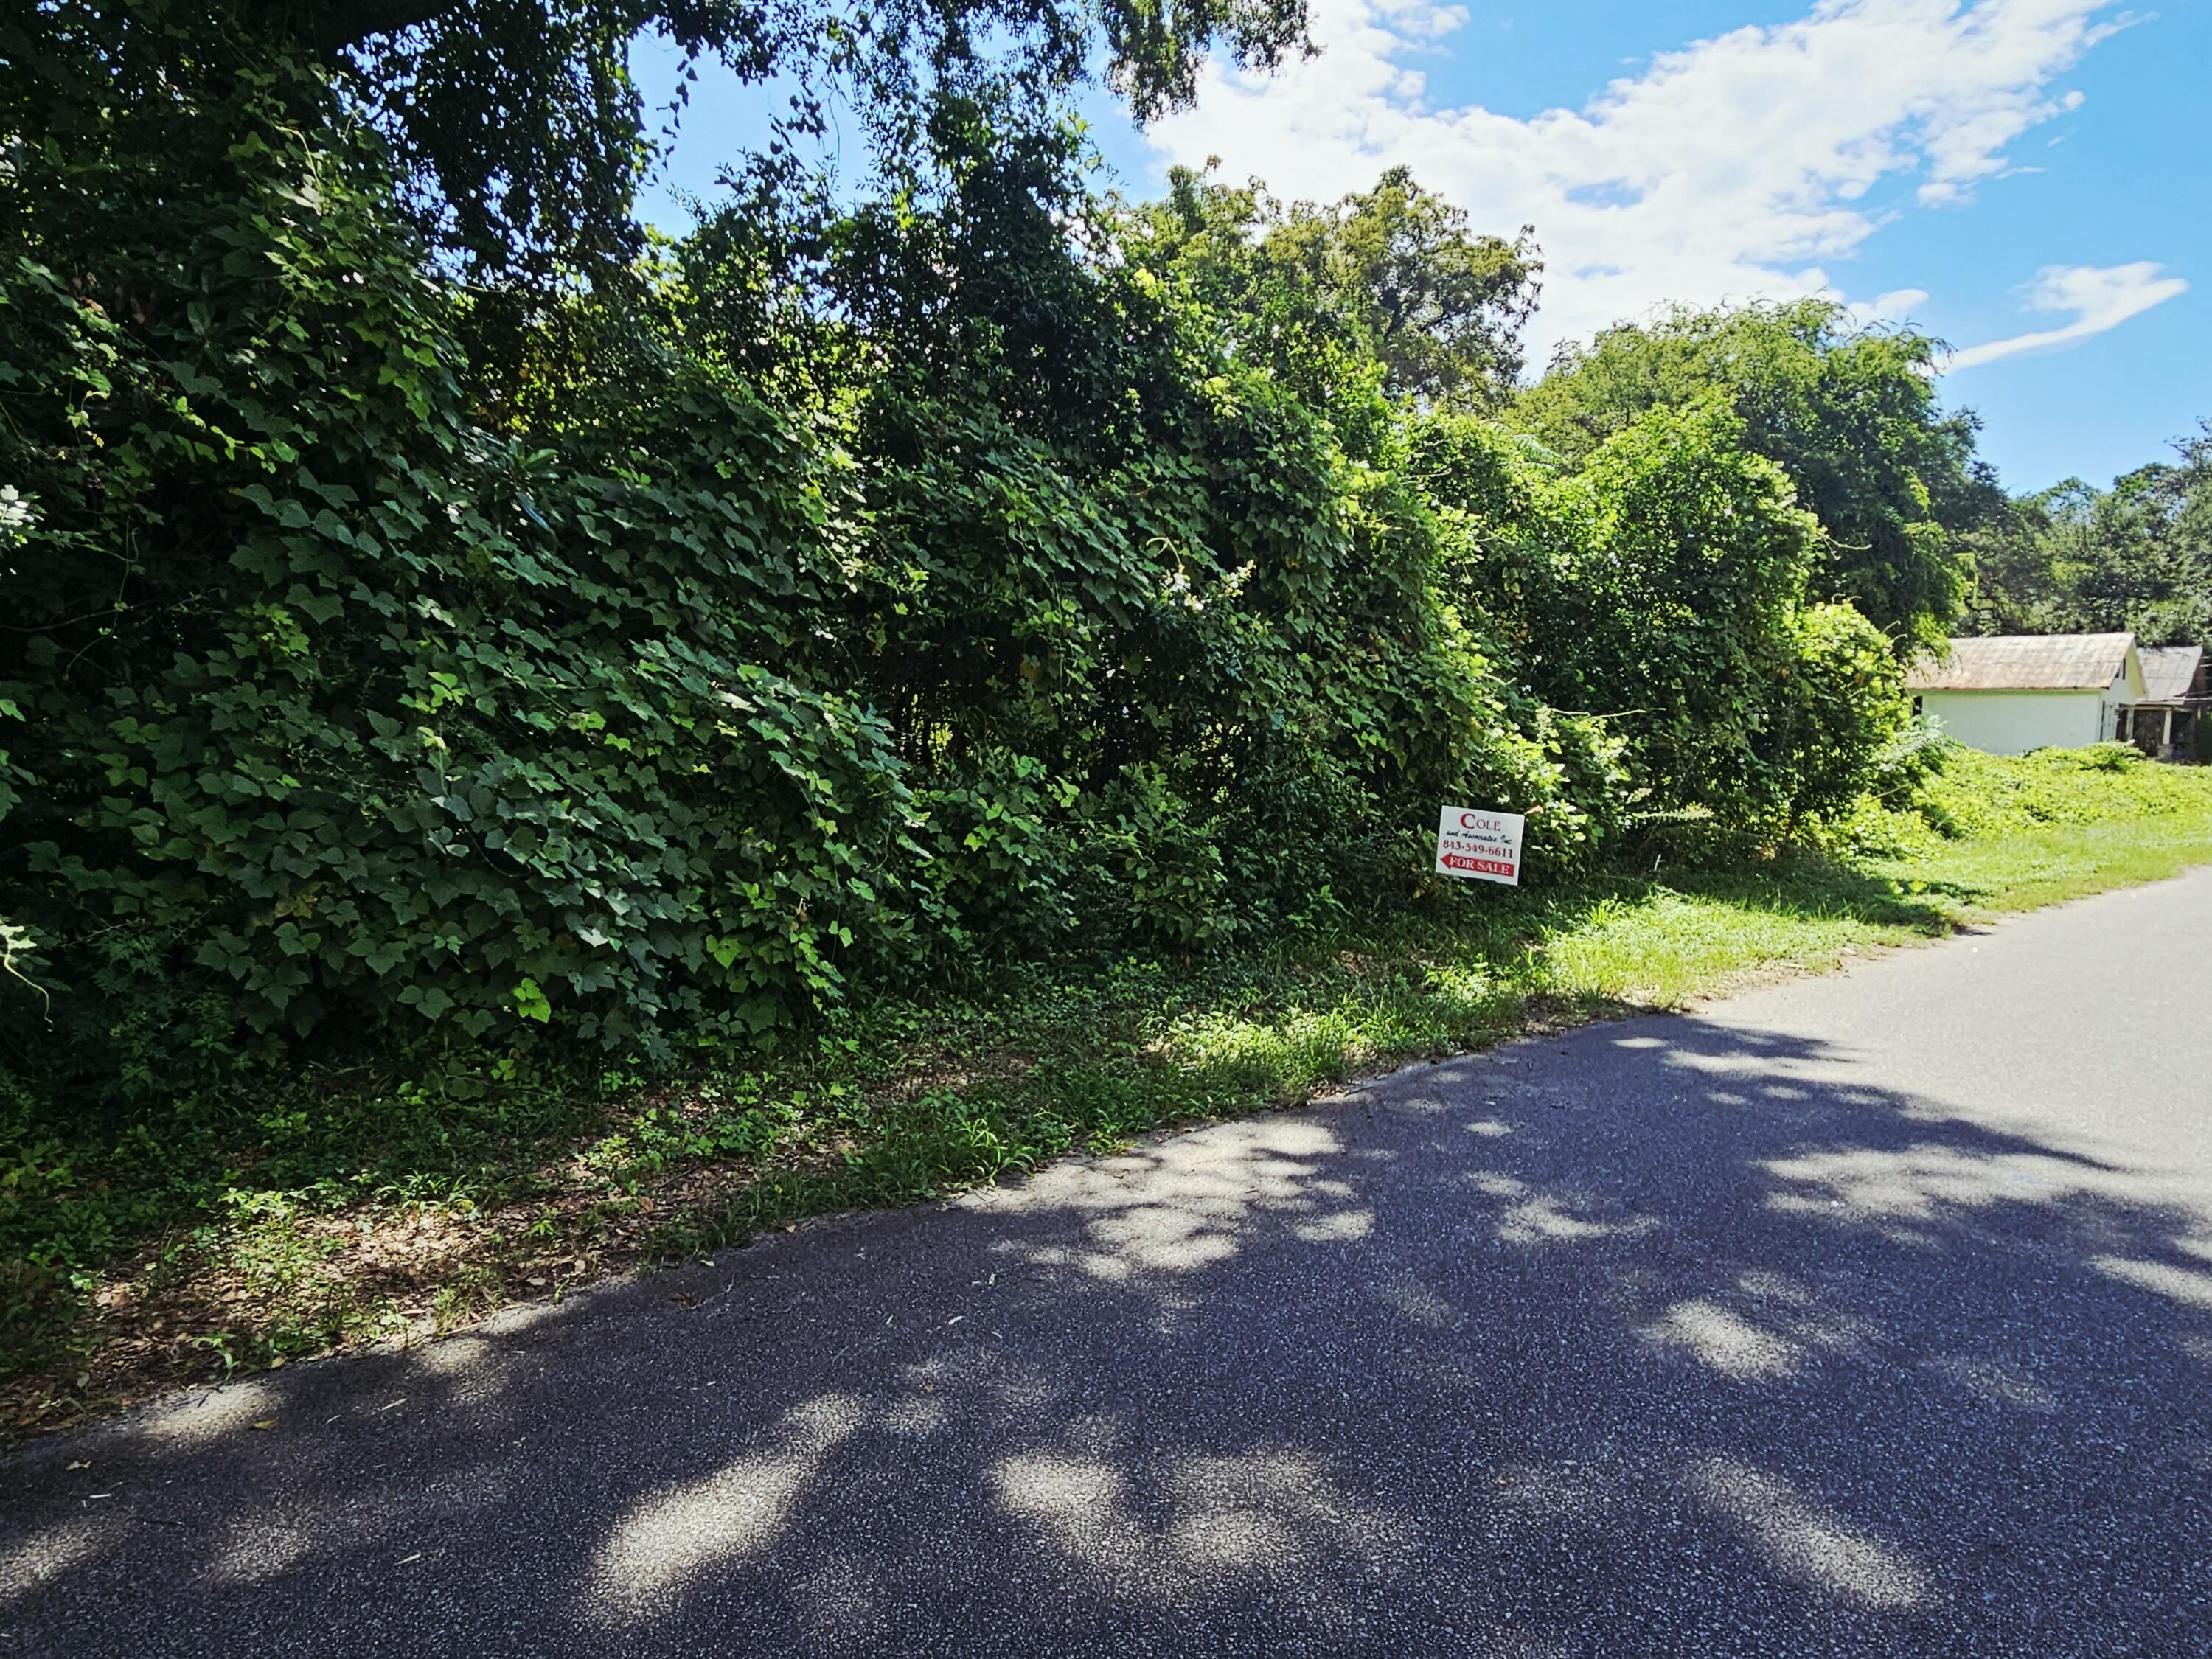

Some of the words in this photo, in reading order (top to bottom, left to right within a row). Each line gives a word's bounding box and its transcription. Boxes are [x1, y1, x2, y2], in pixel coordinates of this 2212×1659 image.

[1460, 813, 1501, 832] COLE
[1450, 856, 1475, 869] FOR
[1477, 860, 1510, 874] SALE
